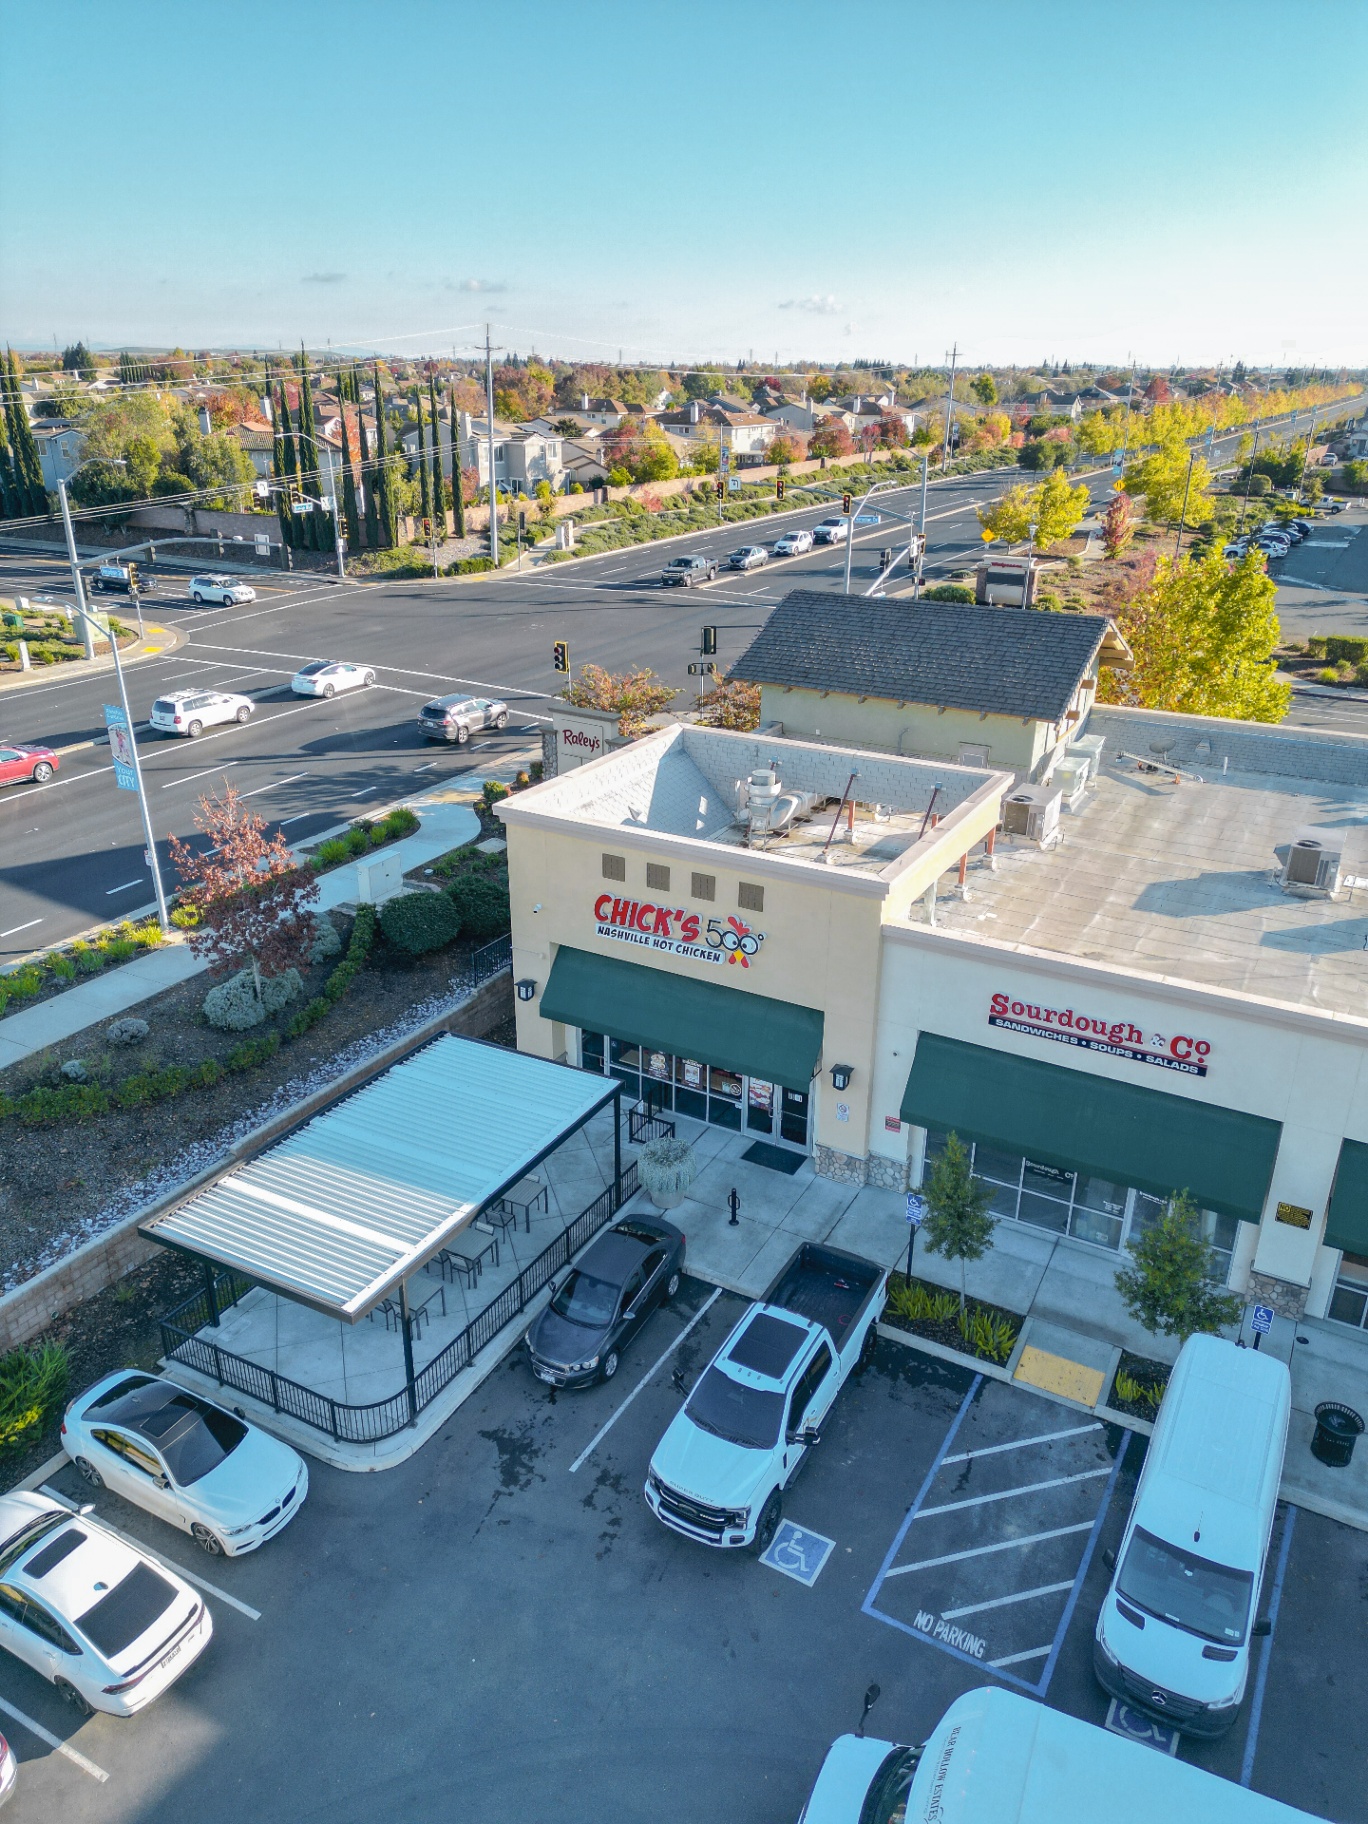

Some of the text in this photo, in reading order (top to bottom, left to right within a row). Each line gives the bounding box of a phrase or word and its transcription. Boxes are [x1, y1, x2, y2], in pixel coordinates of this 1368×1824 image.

[562, 729, 600, 753] Raley's
[117, 774, 135, 788] CITY
[594, 893, 702, 943] CHICK'S
[597, 925, 721, 962] NASHVILLE HOT CHICKEN
[989, 993, 1144, 1045] Sourdough
[1150, 1033, 1166, 1048] &
[995, 1018, 1199, 1075] SANDWICHES SOUPS SALADS
[913, 1609, 986, 1658] NO PARKING
[928, 1783, 944, 1821] ESTATES
